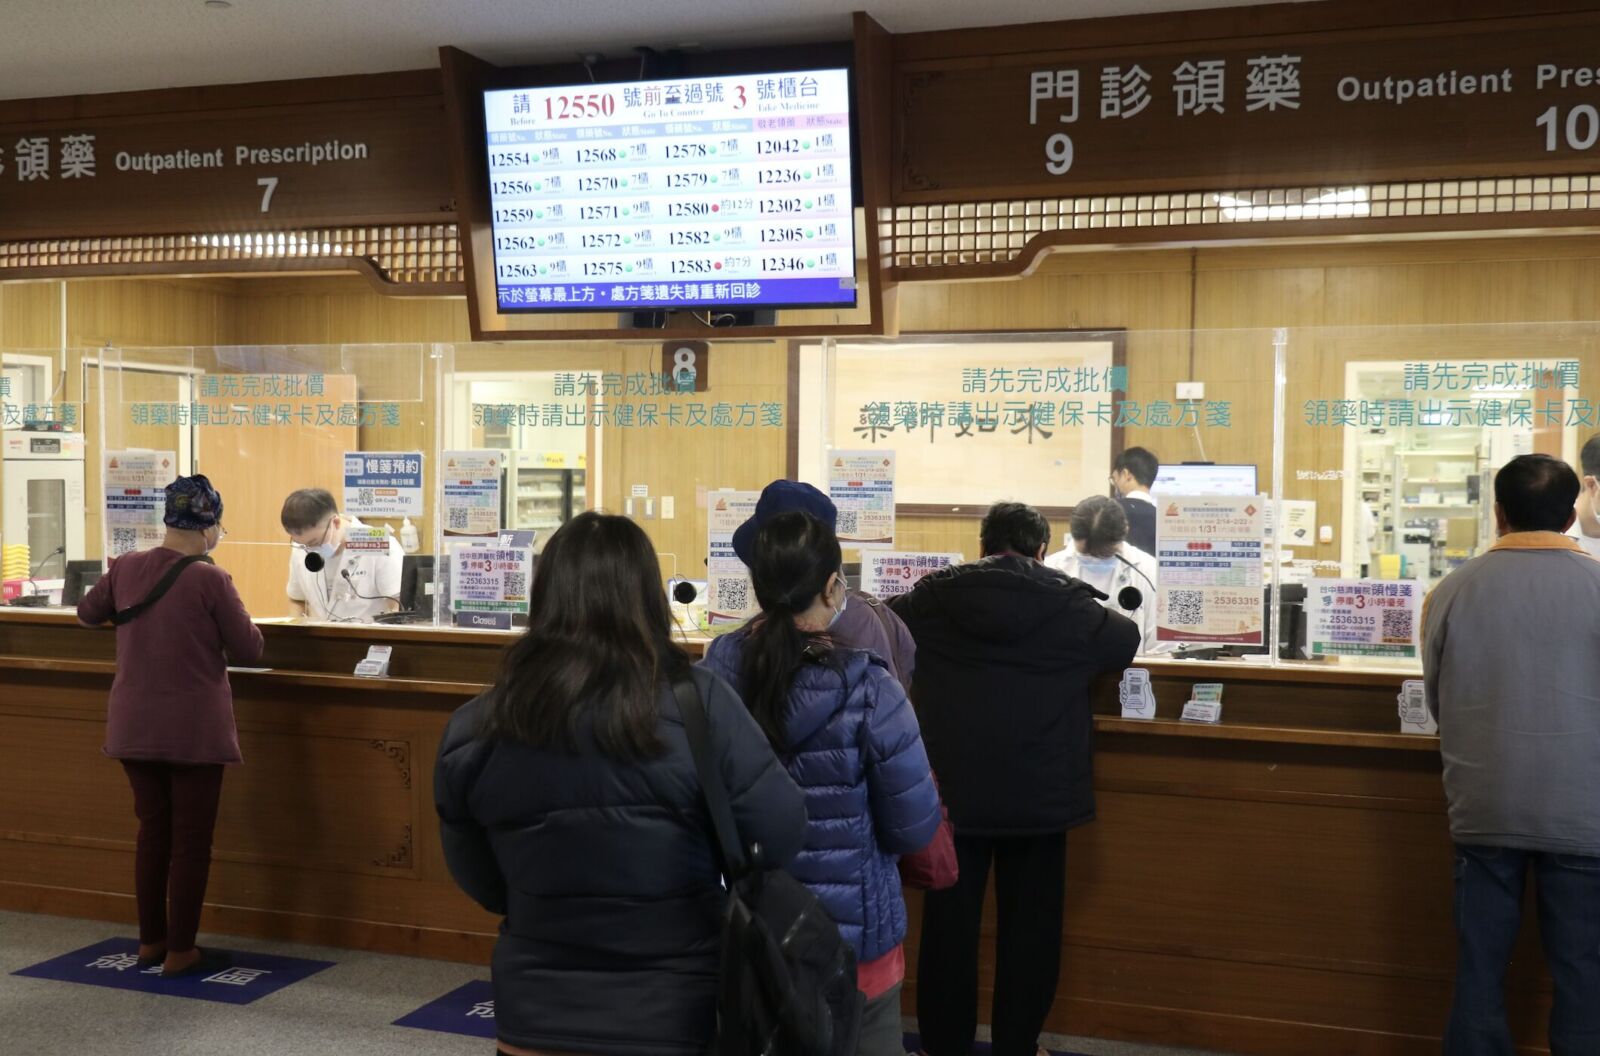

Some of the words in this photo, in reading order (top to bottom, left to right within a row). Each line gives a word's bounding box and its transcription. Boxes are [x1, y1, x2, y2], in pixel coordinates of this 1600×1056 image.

[1029, 55, 1301, 125] 門診領藥
[1337, 68, 1512, 104] Outpatient
[1536, 64, 1600, 90] Pre
[513, 93, 531, 115] 請
[545, 93, 615, 121] 12550
[623, 82, 724, 108] 號前至過號
[733, 85, 747, 110] 3
[757, 76, 819, 101] 號櫃台
[1536, 104, 1600, 152] 10
[665, 144, 707, 159] 12578
[757, 139, 800, 154] 12042
[0, 134, 96, 182] 領藥
[115, 147, 224, 174] Outpatient
[235, 140, 368, 166] Prescription
[491, 153, 530, 166] 12554
[576, 149, 617, 163] 12568
[1045, 134, 1074, 175] 9
[578, 177, 618, 191] 12570
[666, 173, 708, 187] 12579
[758, 169, 801, 184] 12236
[257, 177, 279, 213] 7
[493, 181, 532, 195] 12556
[580, 206, 619, 220] 12571
[668, 202, 709, 217] 12580
[759, 198, 802, 214] 12302
[495, 208, 533, 223] 12559
[581, 234, 621, 248] 12572
[669, 231, 710, 245] 12582
[760, 228, 803, 243] 12305
[497, 237, 535, 250] 12562
[499, 264, 537, 278] 12563
[583, 262, 623, 276] 12575
[671, 260, 712, 274] 12583
[761, 257, 804, 272] 12346
[672, 347, 697, 385] 8
[962, 366, 1129, 394] 請先完成批價
[1404, 361, 1580, 391] 請先完成批價
[201, 374, 325, 397] 請先完成批價
[554, 372, 697, 397] 請先完成批價
[131, 404, 401, 427] 領藥時請出示健保卡及處方箋
[473, 402, 784, 427] 領藥時請出示健保卡及處方箋
[867, 400, 1233, 428] 領藥時請出示健保卡及處方箋
[1303, 399, 1600, 427] 領藥時請出示健保卡及
[366, 459, 419, 474] 慢箋預約
[1198, 525, 1217, 534] 1/31
[1214, 597, 1260, 605] 25363315
[472, 616, 497, 626] Closed
[1330, 616, 1375, 625] 25363315
